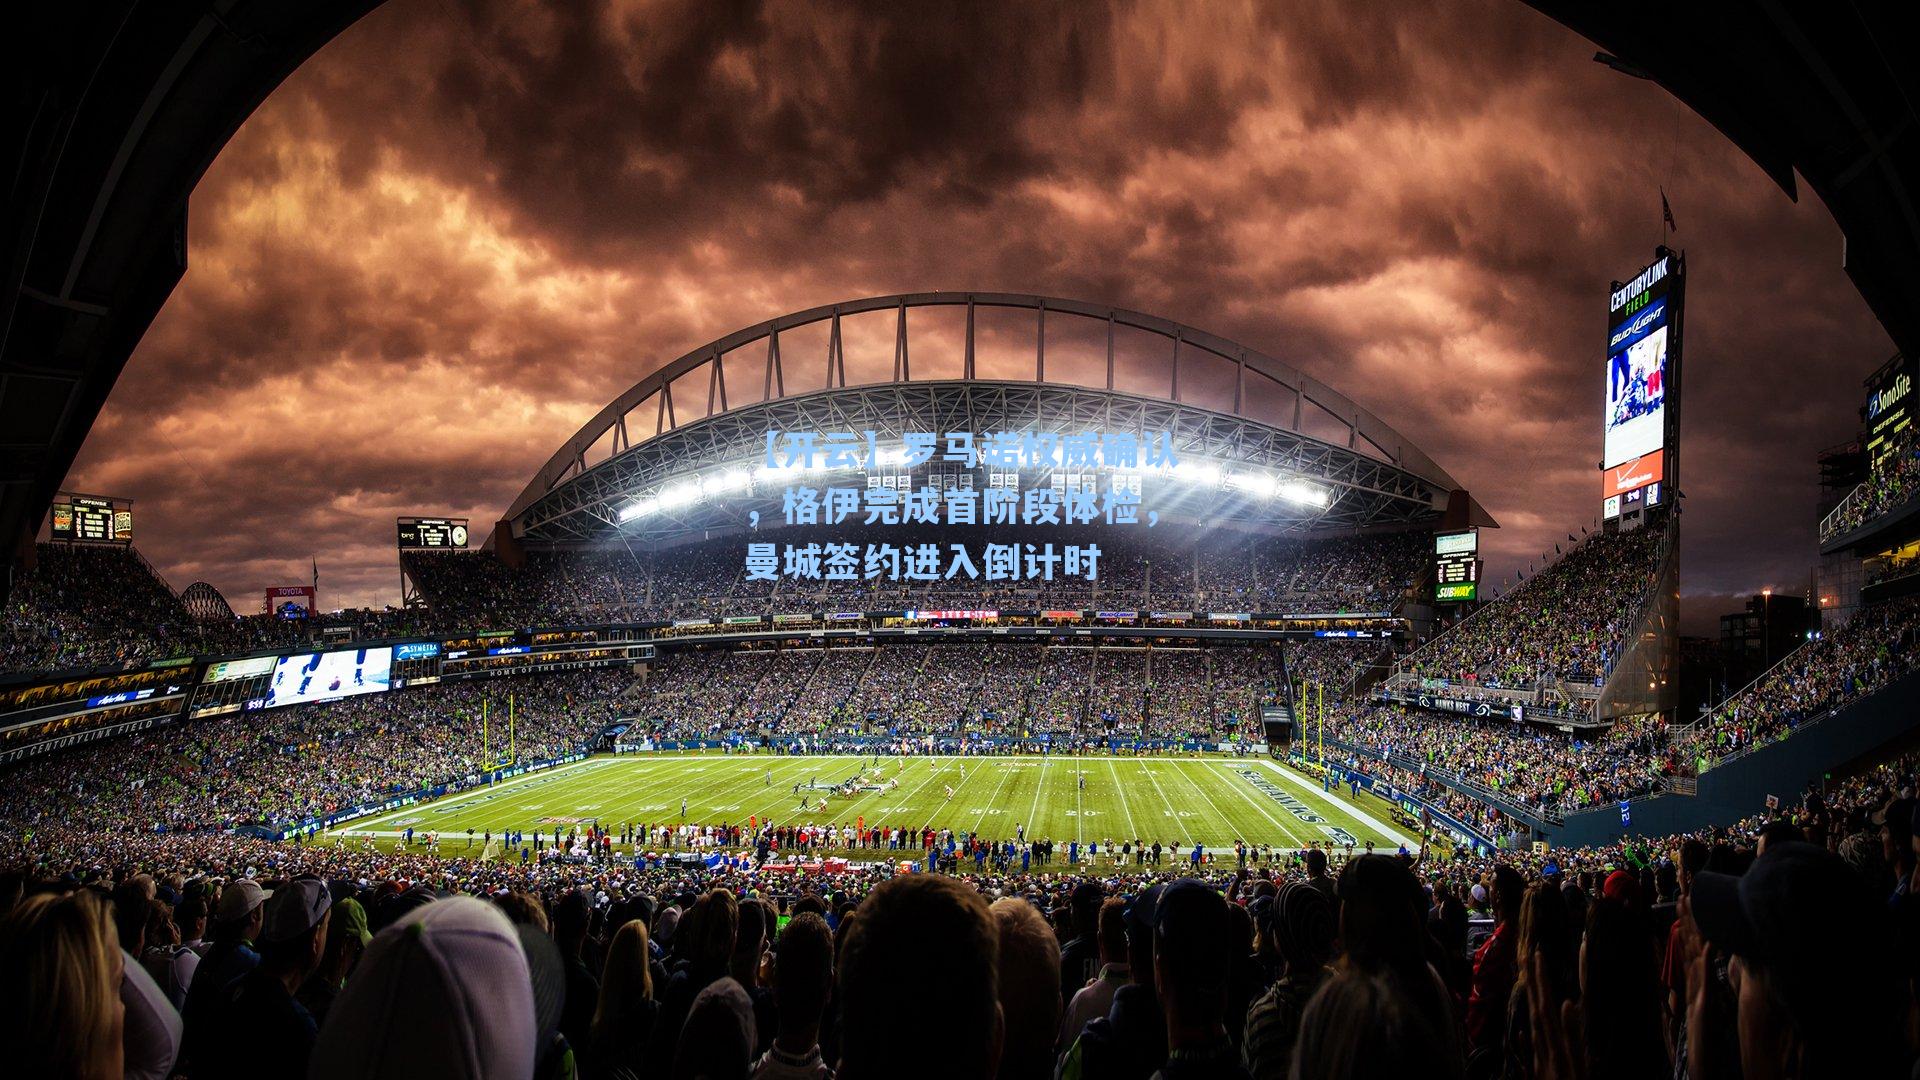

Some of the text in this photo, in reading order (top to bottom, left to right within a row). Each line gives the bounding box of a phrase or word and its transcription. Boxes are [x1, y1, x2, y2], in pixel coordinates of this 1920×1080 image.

[1610, 256, 1669, 312] CENTURYLINK
[1625, 290, 1650, 316] FIELD
[1610, 305, 1665, 346] BUD LIGHT
[1877, 373, 1911, 414] SonoSite
[1437, 585, 1474, 598] SUBWAY
[410, 645, 437, 653] SYMETRA
[490, 669, 516, 677] HOME
[10, 720, 153, 762] TO CENTURYLINK FIELD
[1233, 769, 1330, 823] SEAHAWKS
[1620, 806, 1630, 822] 12
